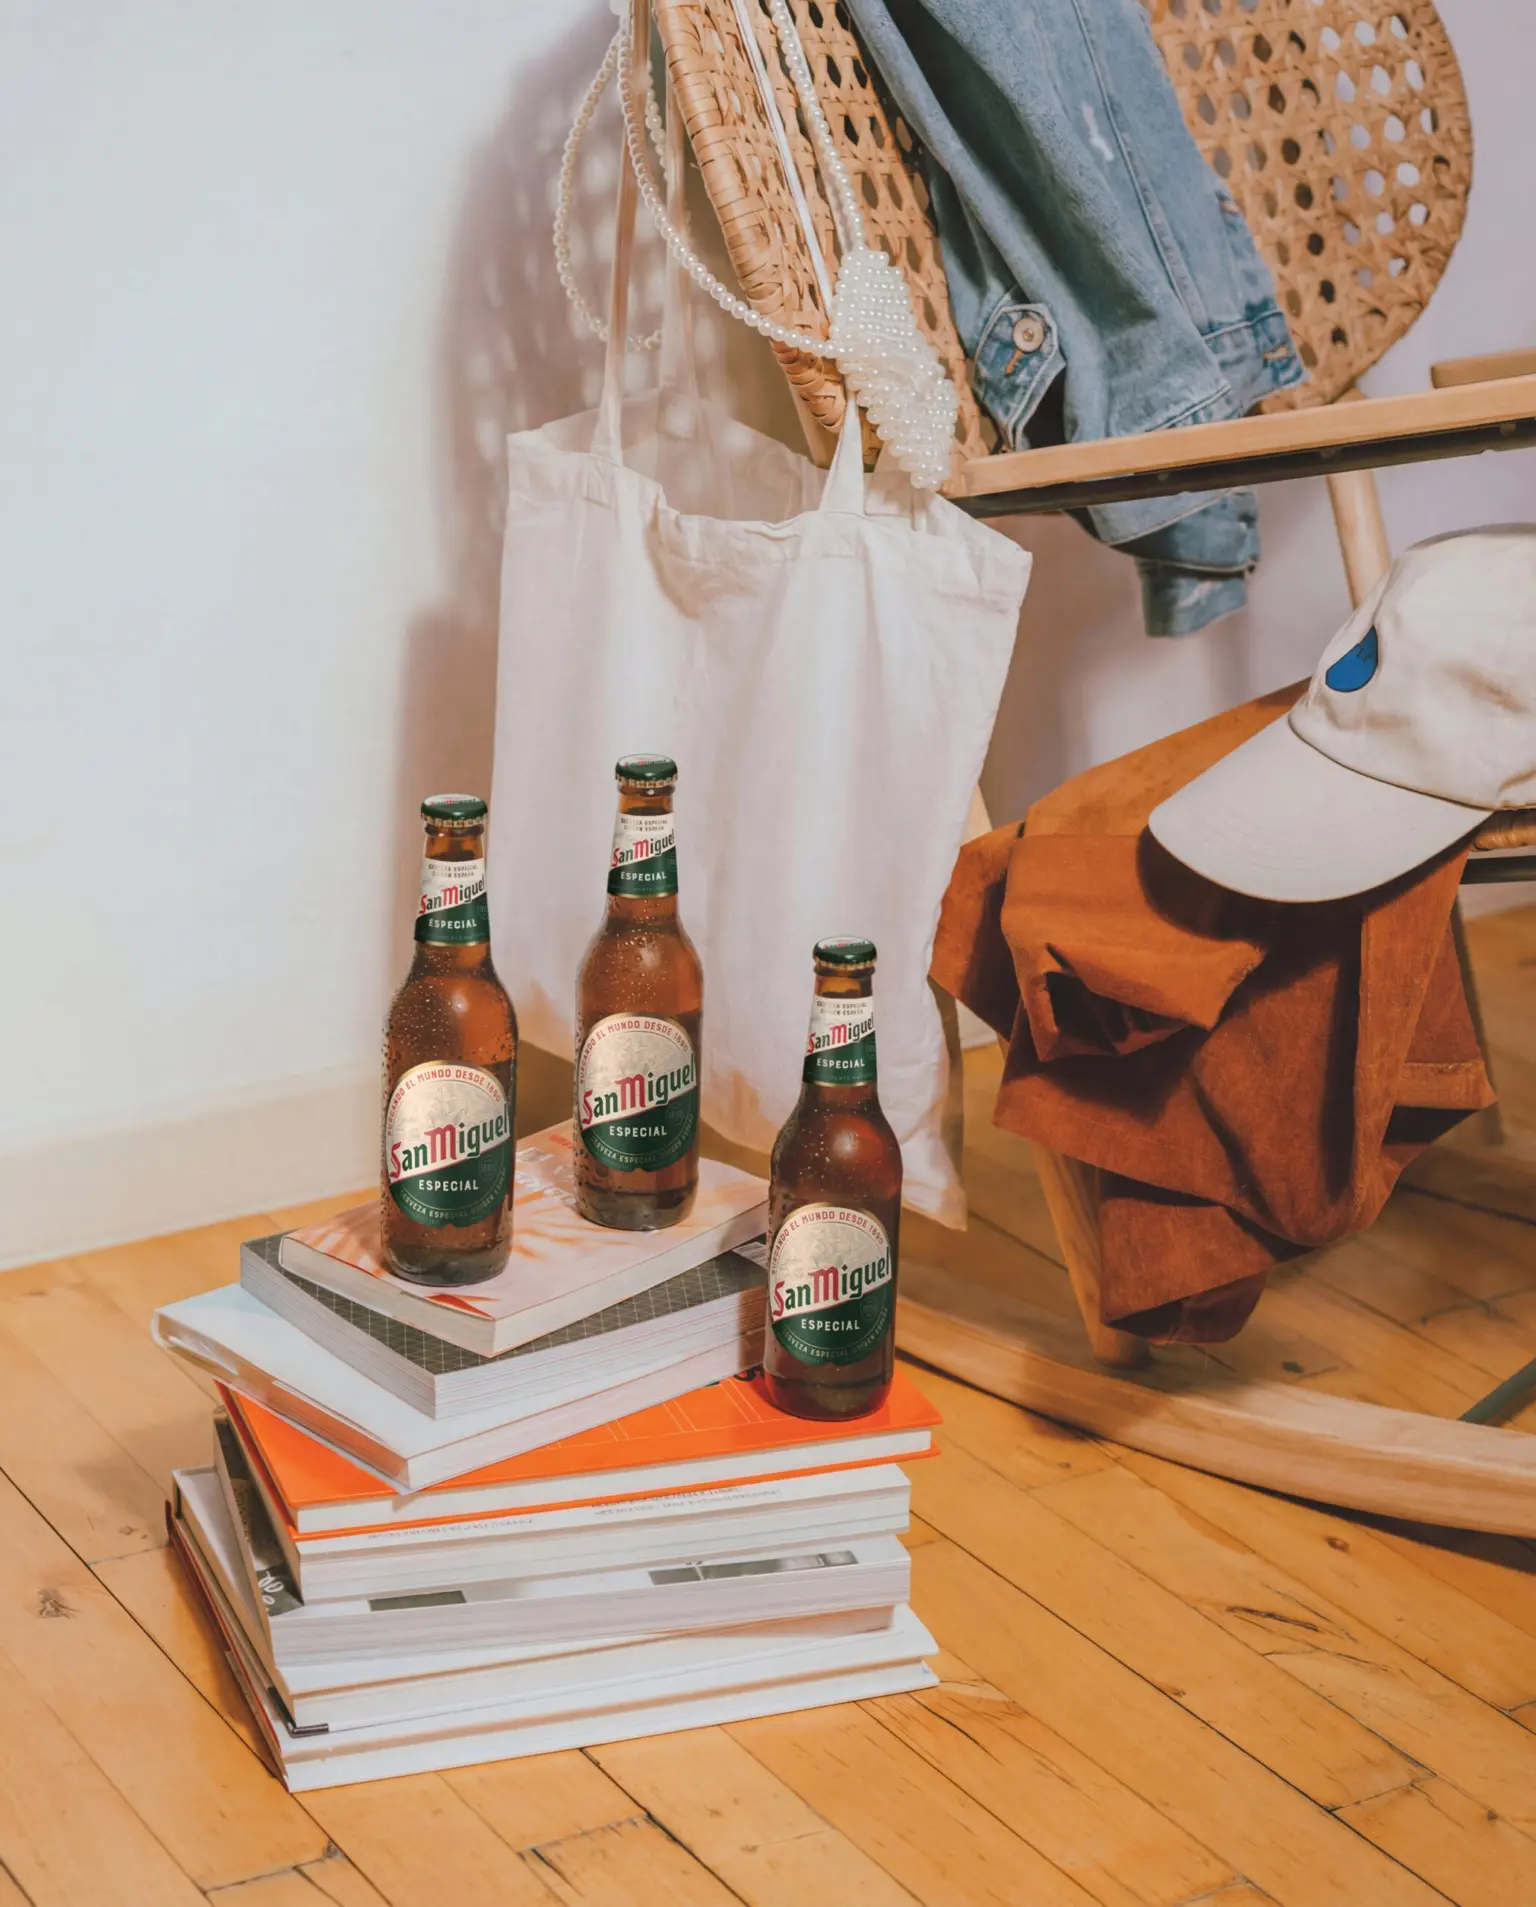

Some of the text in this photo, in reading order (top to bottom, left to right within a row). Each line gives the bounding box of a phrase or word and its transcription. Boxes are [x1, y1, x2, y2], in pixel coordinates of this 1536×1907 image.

[621, 871, 667, 882] ESPECIAL
[428, 918, 478, 930] ESPECIAL
[596, 1030, 606, 1041] EL
[608, 1020, 640, 1035] MUNDO
[644, 1020, 673, 1036] DESDE
[674, 1032, 689, 1052] 1890
[816, 1058, 866, 1069] ESPECIAL
[406, 1079, 416, 1091] EL
[417, 1068, 452, 1084] MUNDO
[456, 1069, 485, 1086] DESDE
[486, 1082, 501, 1103] 1890
[609, 1125, 668, 1138] ESPECIAL
[418, 1179, 479, 1192] ESPECIAL
[429, 1210, 468, 1220] ESPECIAL
[790, 1220, 800, 1231] EL
[802, 1210, 835, 1225] MUNDO
[839, 1212, 868, 1228] DESDE
[869, 1224, 884, 1245] 1890
[801, 1318, 860, 1332] ESPECIAL
